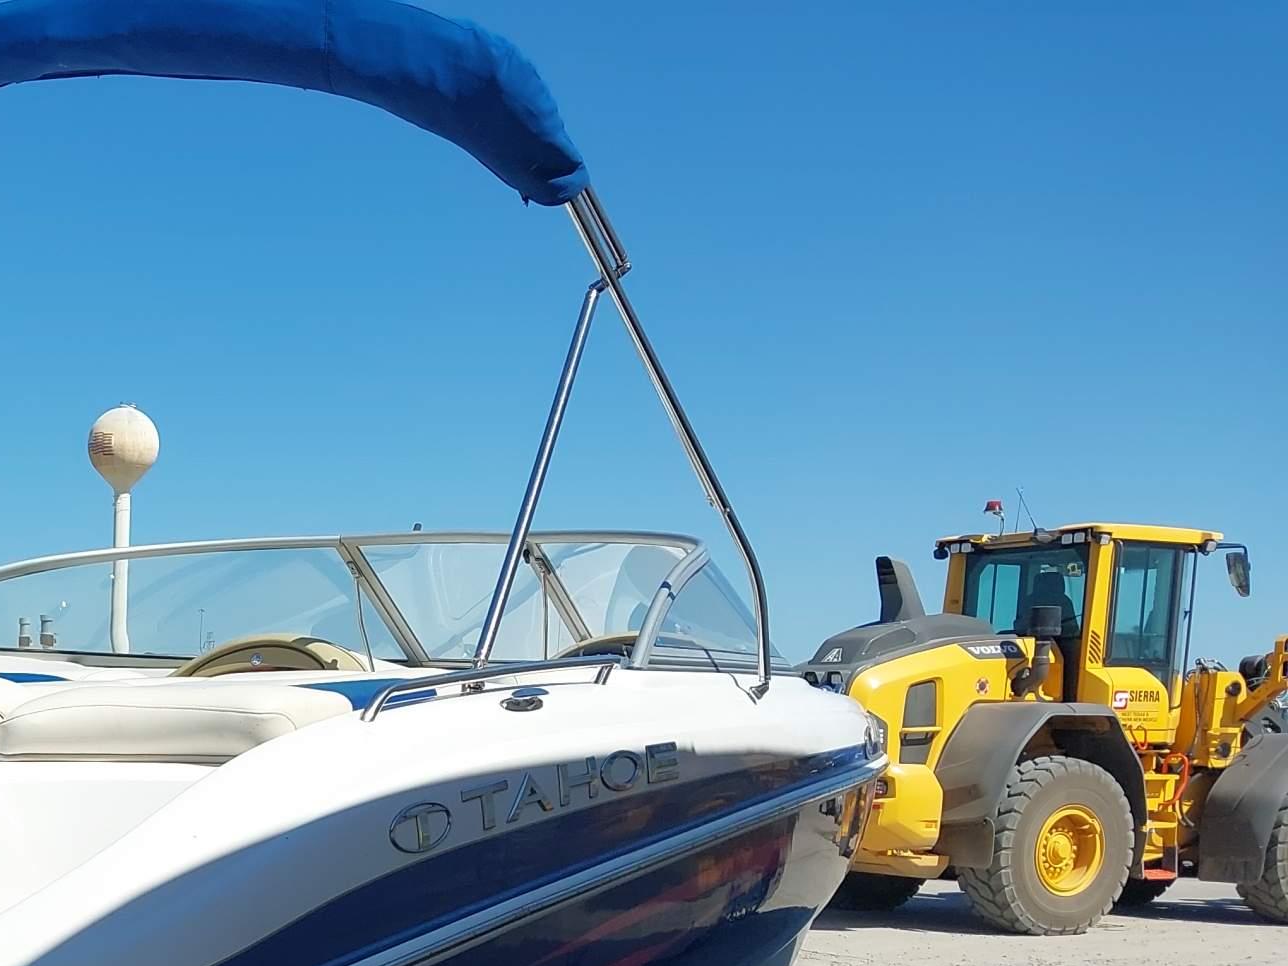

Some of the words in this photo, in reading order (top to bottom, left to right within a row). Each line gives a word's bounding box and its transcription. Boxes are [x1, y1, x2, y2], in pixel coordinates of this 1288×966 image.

[968, 645, 1017, 655] VOLVO
[1129, 690, 1160, 702] SIERRA
[461, 742, 680, 831] TAHOE
